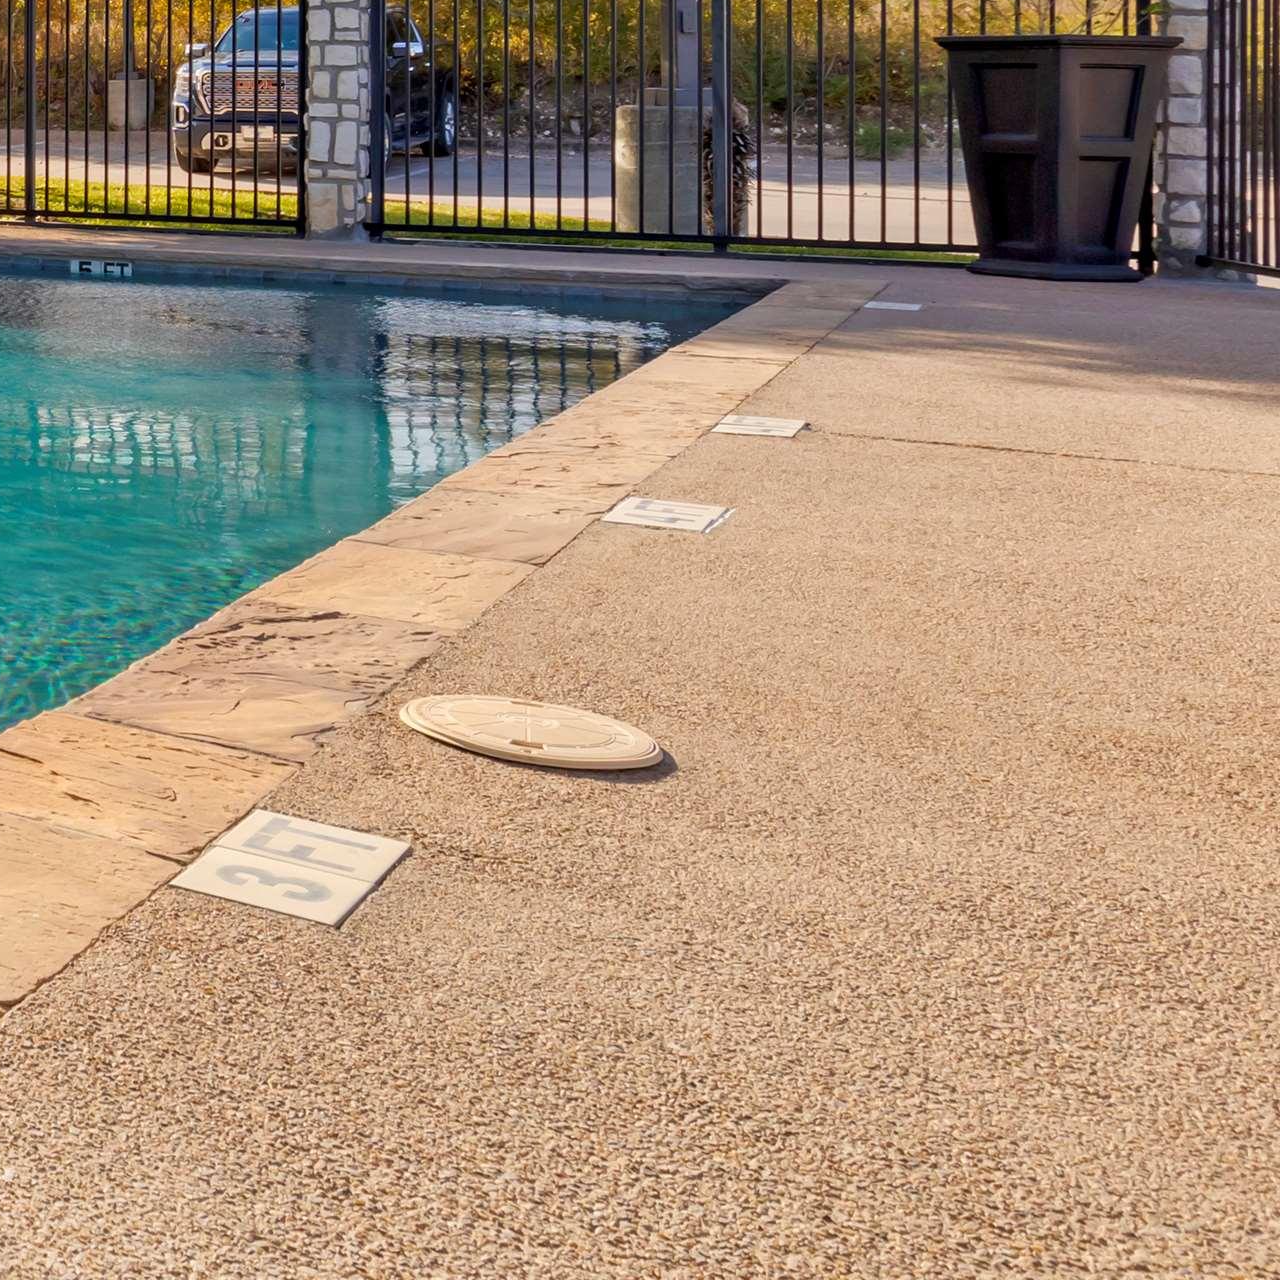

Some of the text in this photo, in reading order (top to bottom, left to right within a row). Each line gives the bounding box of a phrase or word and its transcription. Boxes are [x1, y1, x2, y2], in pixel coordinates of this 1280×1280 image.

[104, 261, 129, 276] FT
[215, 816, 380, 903] 3 FT
